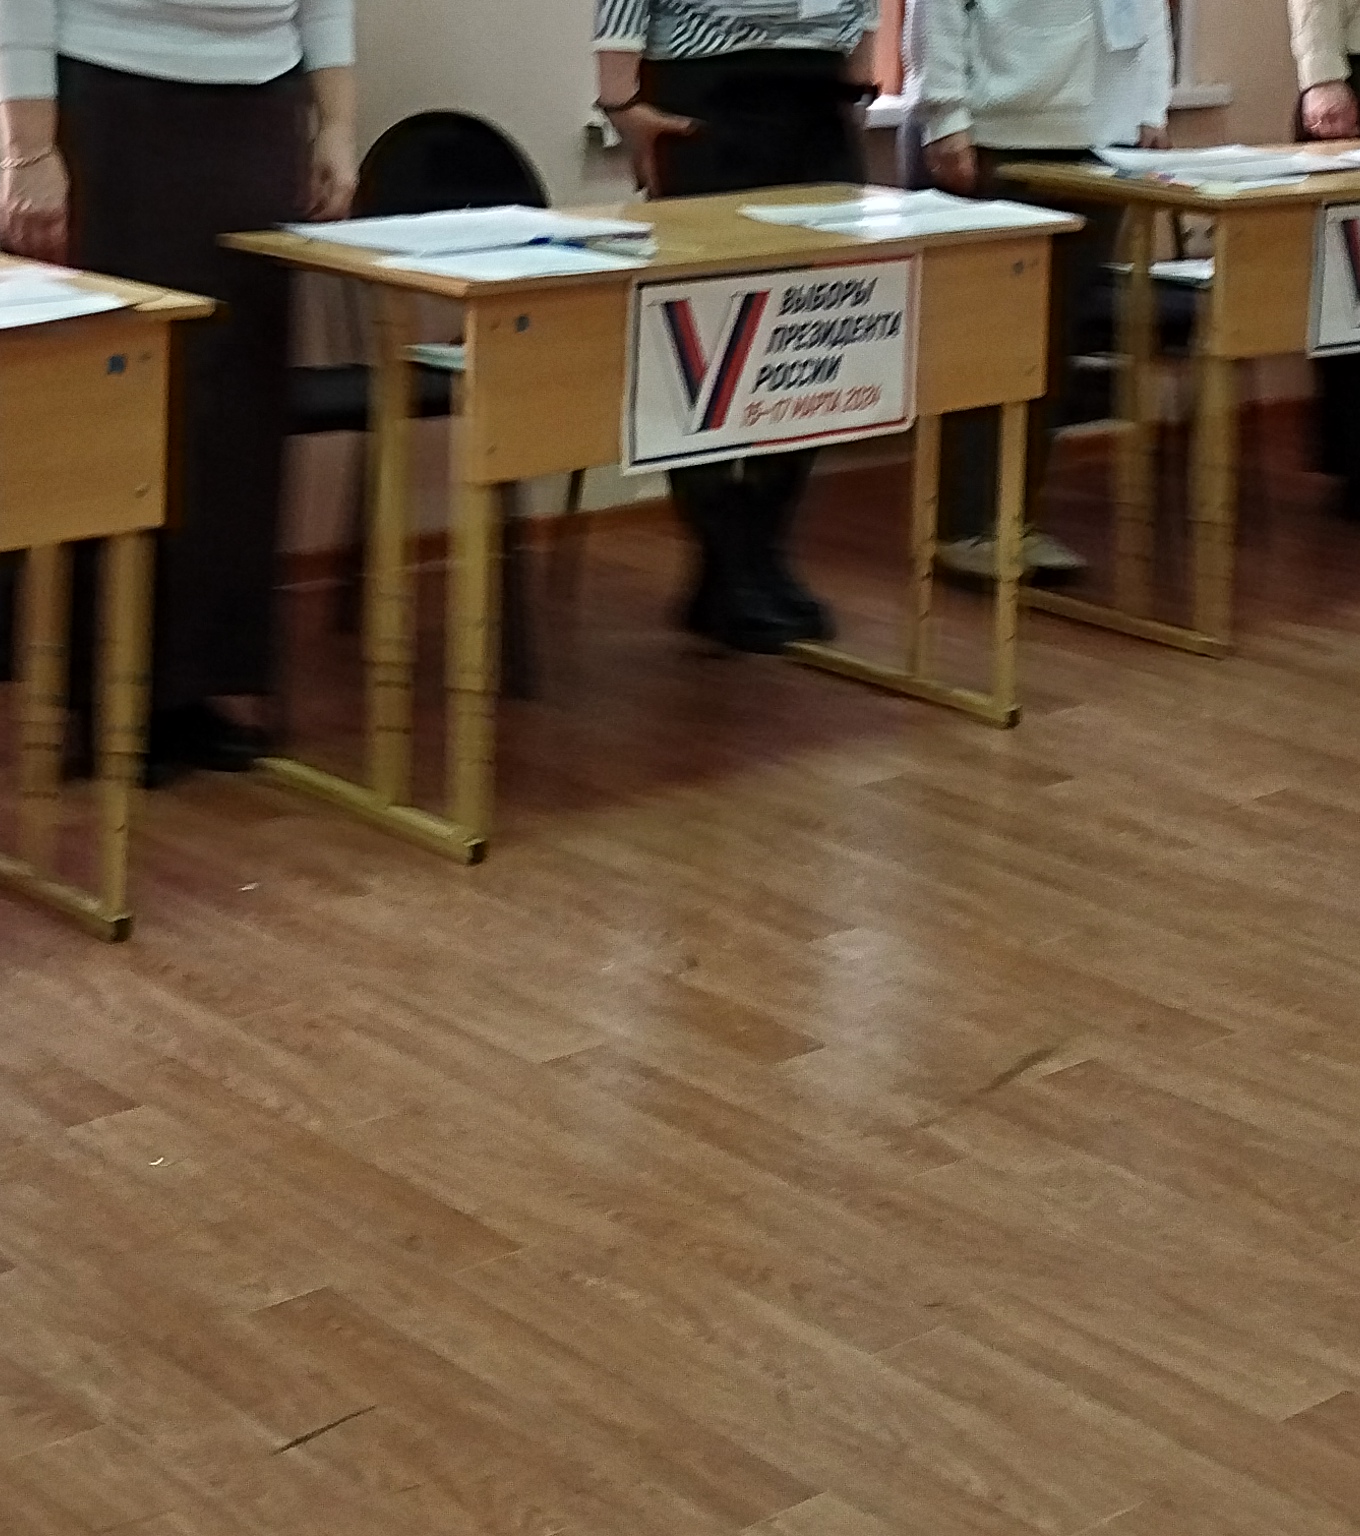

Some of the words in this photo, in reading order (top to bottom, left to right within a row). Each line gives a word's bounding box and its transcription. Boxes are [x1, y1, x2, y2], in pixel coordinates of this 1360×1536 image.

[777, 277, 878, 316] ВЫБОРЫ
[764, 310, 904, 355] ПРЕЗИДЕНТА
[749, 353, 844, 394] РОССИИ
